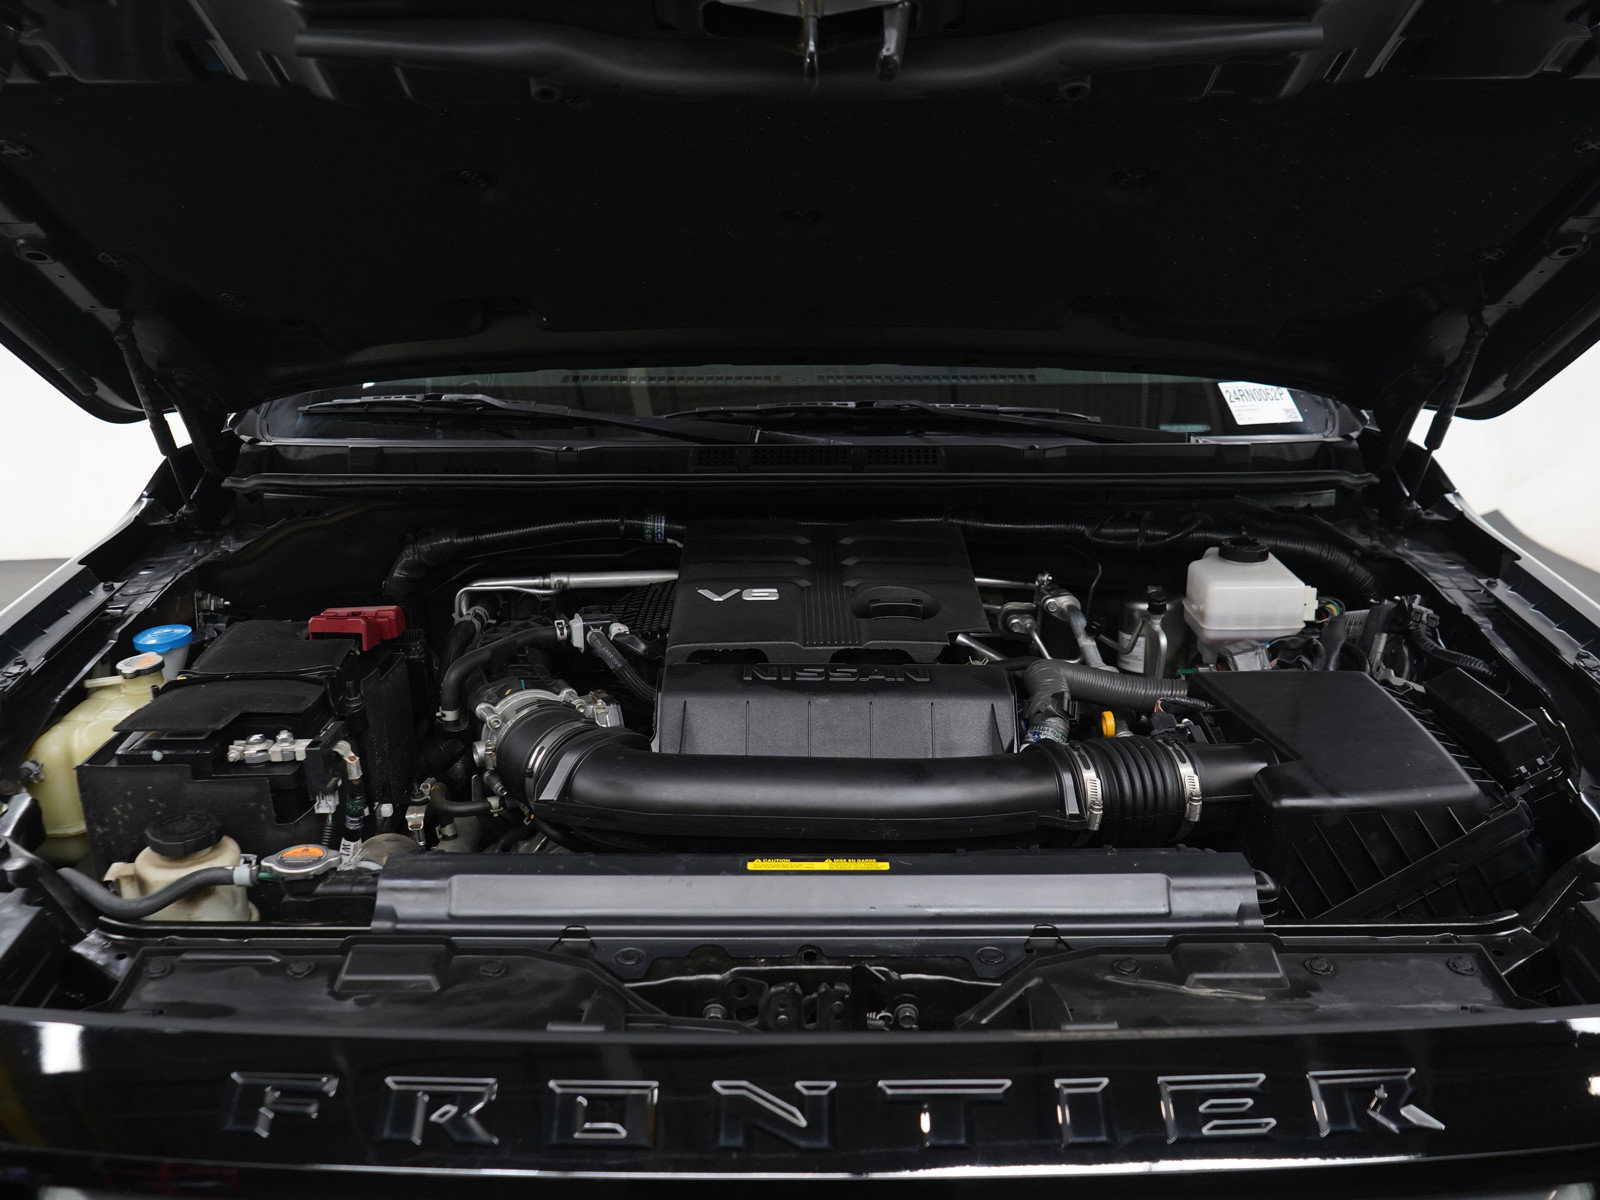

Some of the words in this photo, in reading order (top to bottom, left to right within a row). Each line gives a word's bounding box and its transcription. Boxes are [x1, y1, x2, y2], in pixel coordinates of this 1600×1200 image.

[1225, 387, 1284, 403] 24RN0062P
[698, 587, 780, 602] V6
[742, 665, 931, 683] NISSAN
[220, 1066, 1447, 1149] FRONTIER
